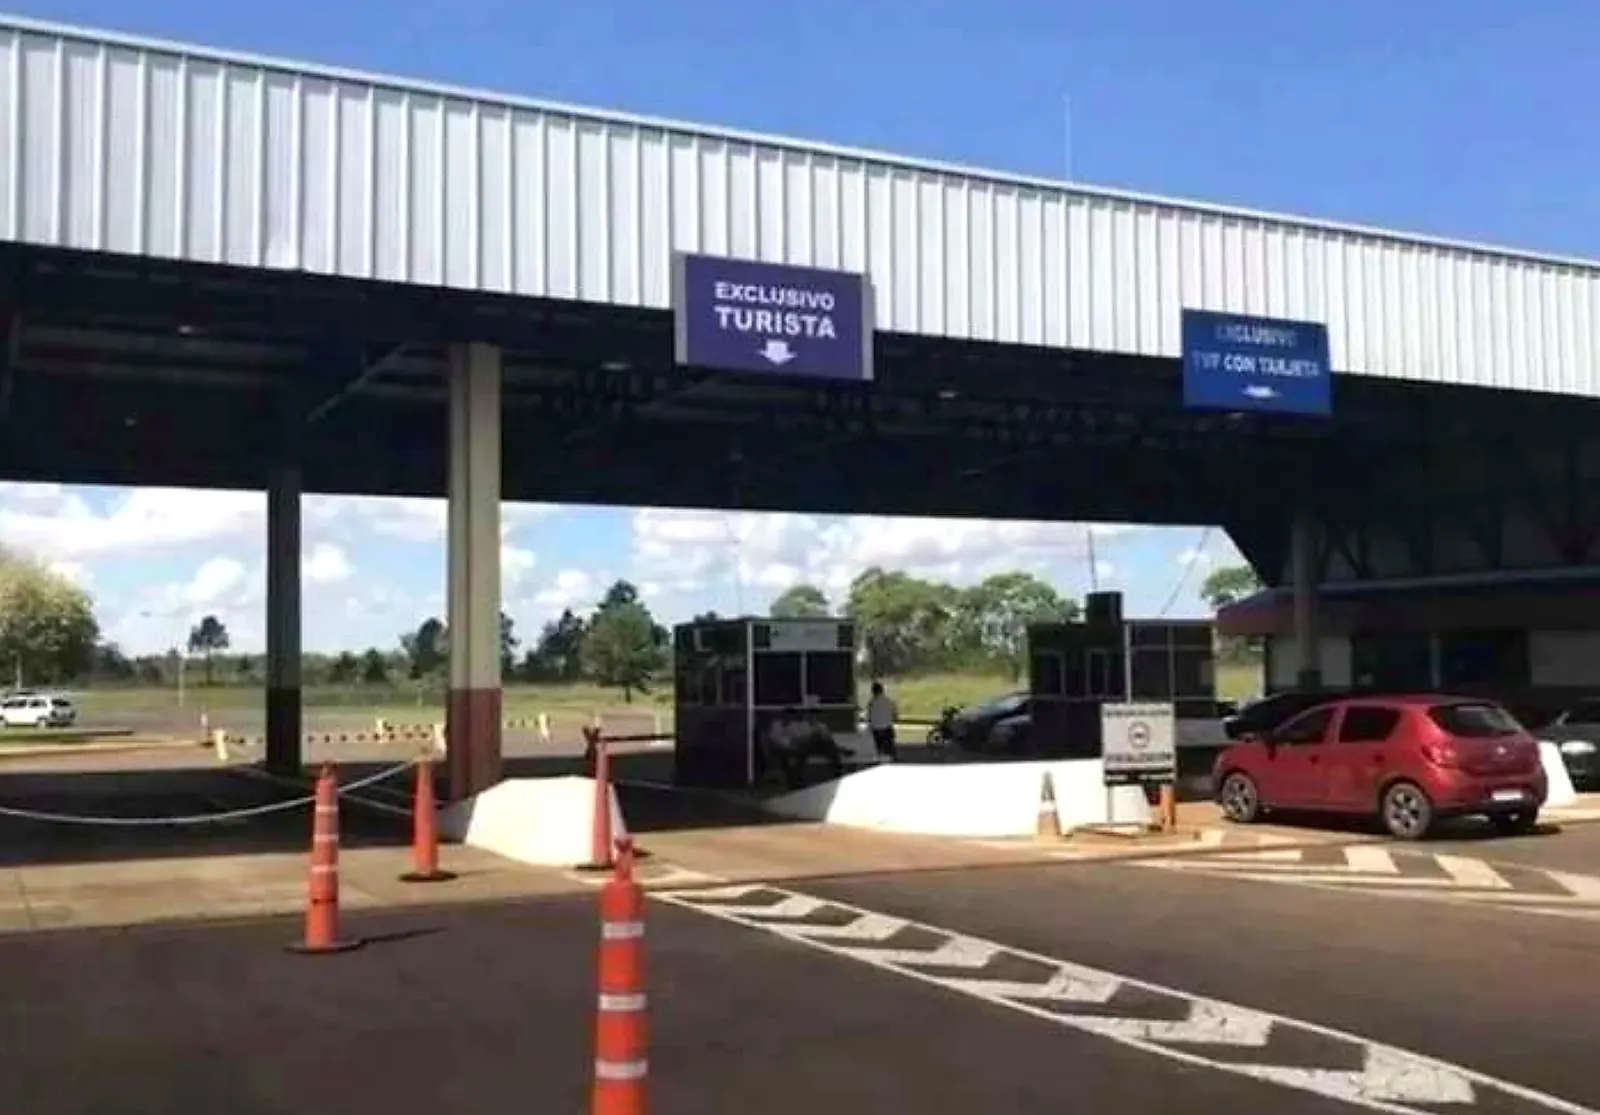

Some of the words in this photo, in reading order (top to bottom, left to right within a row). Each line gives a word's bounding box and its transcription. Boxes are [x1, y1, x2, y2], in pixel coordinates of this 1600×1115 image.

[714, 281, 836, 311] EXCLUSIVO
[713, 305, 837, 339] TURISTA
[1223, 352, 1256, 373] CON
